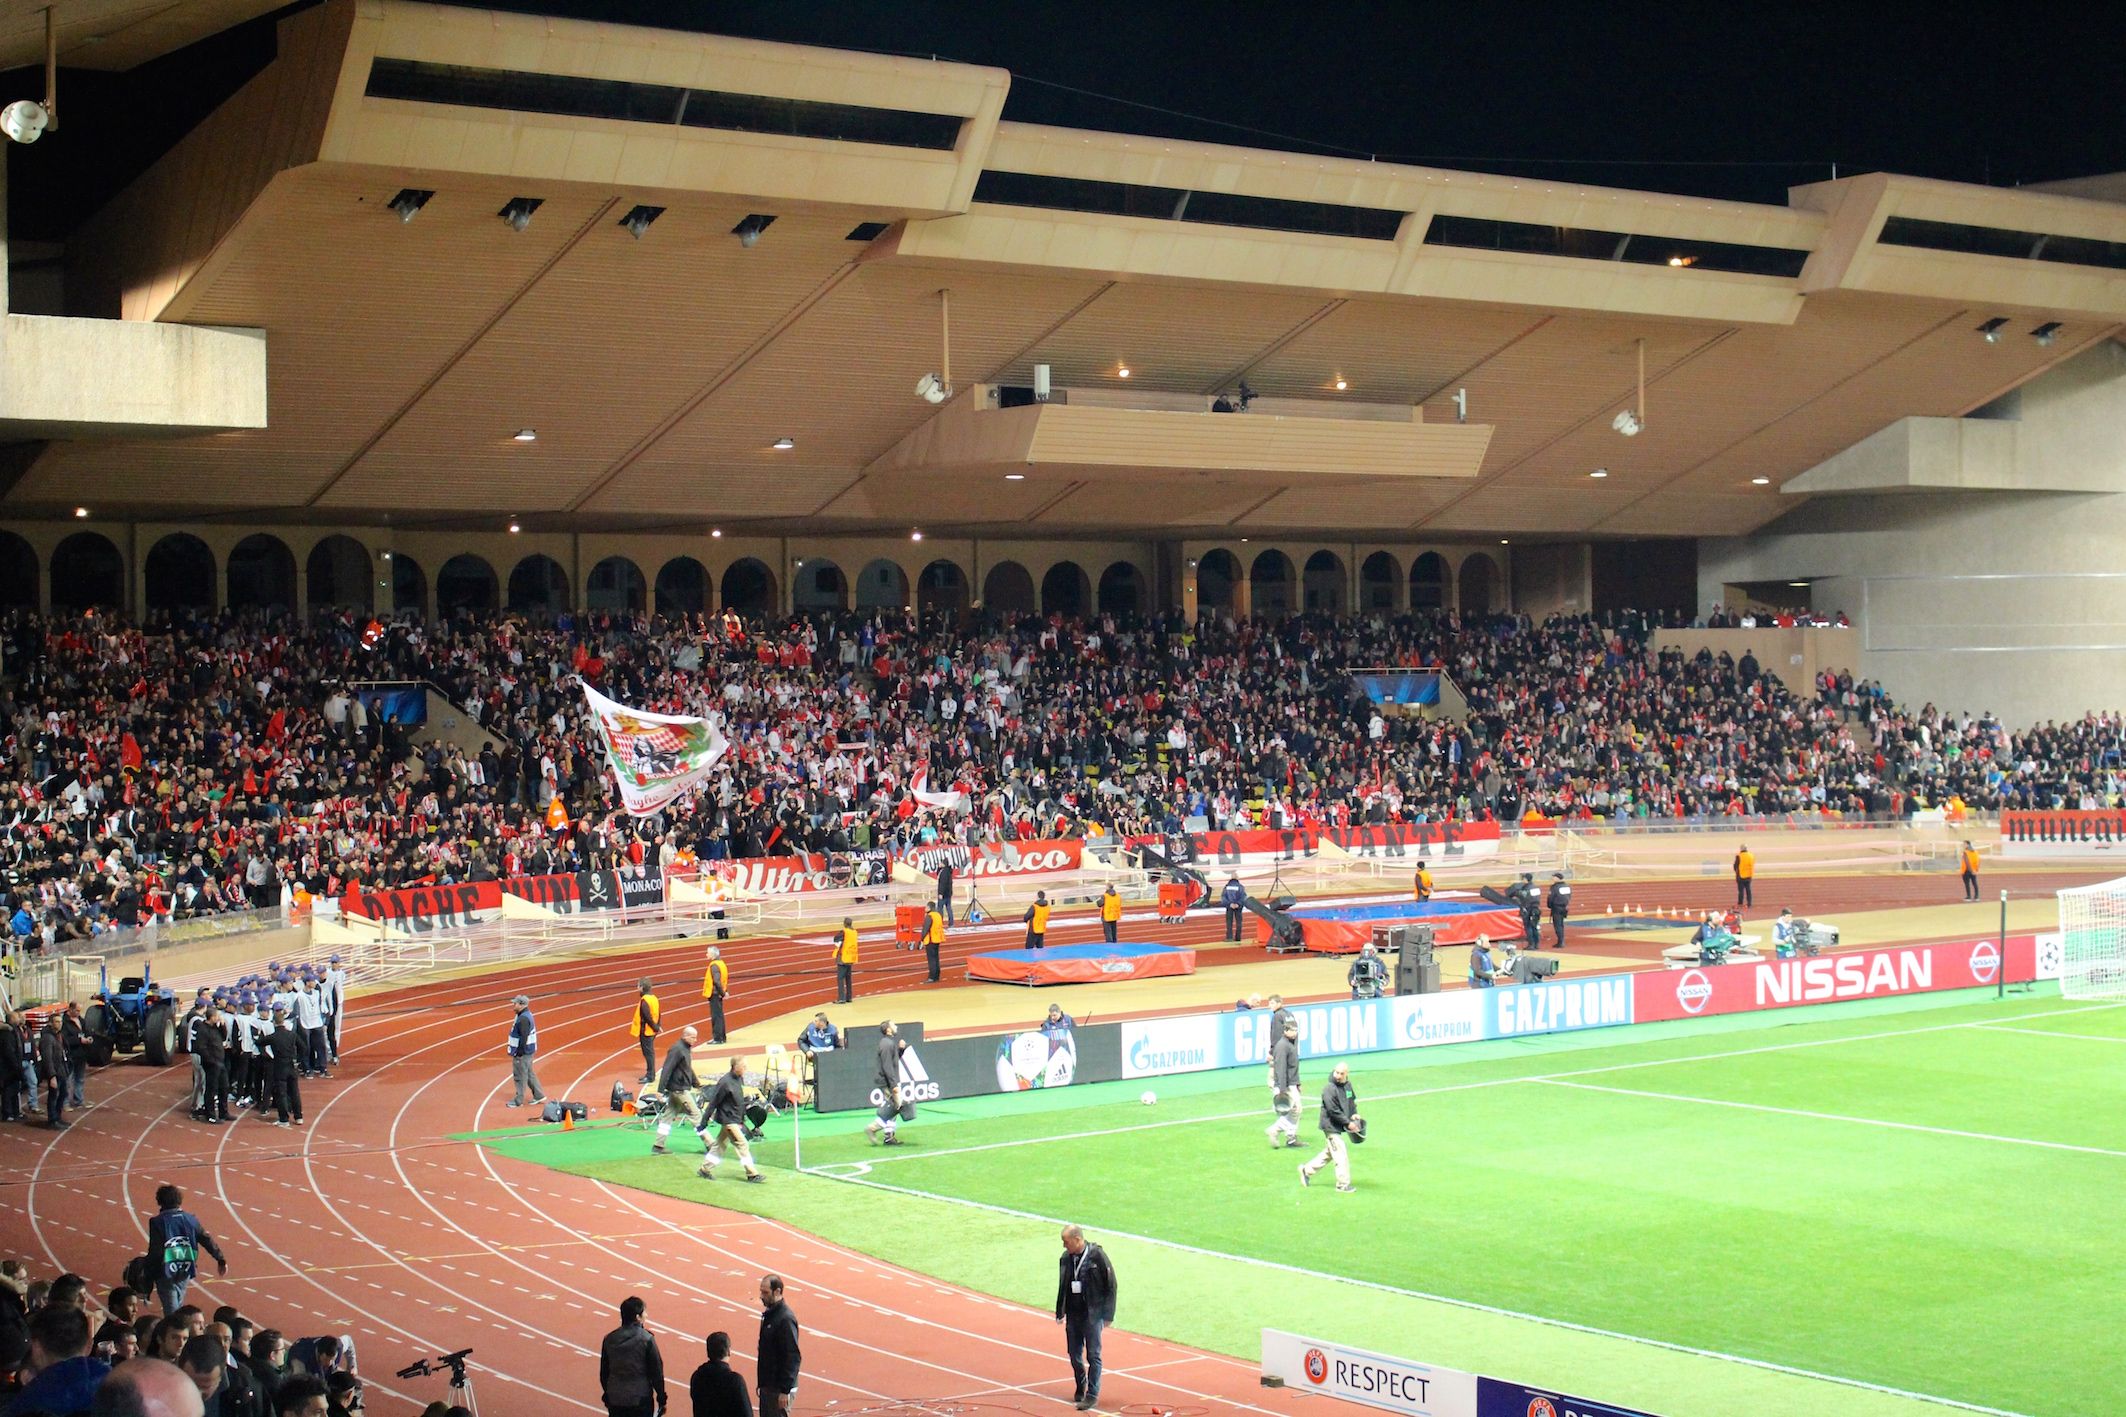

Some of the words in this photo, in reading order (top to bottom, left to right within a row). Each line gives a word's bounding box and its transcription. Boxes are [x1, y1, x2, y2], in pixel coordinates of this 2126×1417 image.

[623, 879, 662, 894] MONACO
[1756, 950, 1932, 1005] NISSAN
[1679, 987, 1711, 999] NISSAN
[1498, 977, 1625, 1034] GAZPROM
[1234, 1003, 1379, 1063] GAPROM
[1425, 1019, 1472, 1041] GAZPROM
[1151, 1048, 1205, 1070] GAZPROM
[870, 1079, 940, 1107] aidas
[174, 1248, 187, 1258] TV
[1307, 1348, 1325, 1362] UEFA
[1335, 1360, 1430, 1404] RESPECT
[1533, 1399, 1551, 1411] UEFA
